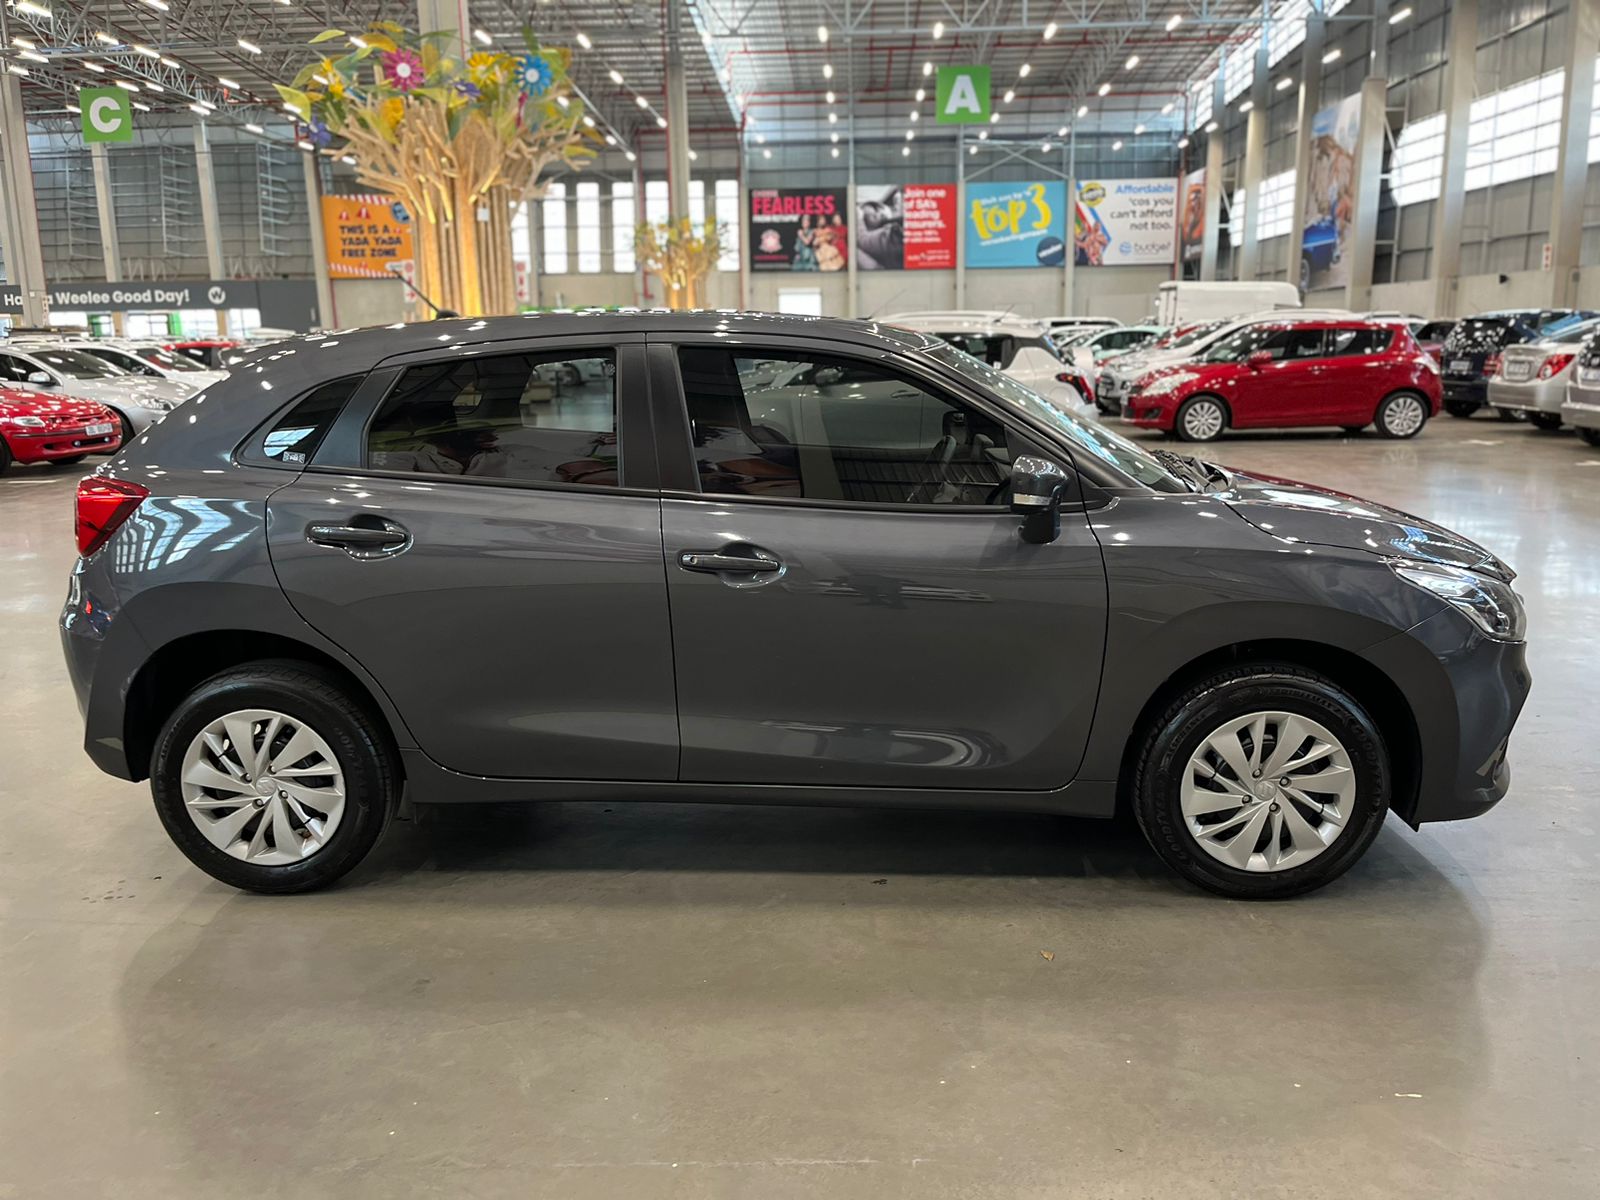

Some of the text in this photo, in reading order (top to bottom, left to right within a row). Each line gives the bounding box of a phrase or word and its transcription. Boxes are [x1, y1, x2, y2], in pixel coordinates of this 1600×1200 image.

[944, 75, 981, 114] A
[89, 97, 122, 133] C
[903, 188, 947, 199] Join one
[1116, 184, 1175, 194] Affordable
[752, 195, 836, 216] FEARLESS
[1129, 198, 1175, 207] 'cos you
[970, 183, 1052, 239] top 3
[1110, 208, 1174, 219] can't afford
[339, 224, 390, 234] THIS IS A
[1129, 221, 1172, 230] not too.
[341, 237, 402, 246] YADA YADA
[342, 248, 397, 257] FREE ZONE
[55, 291, 110, 305] Weelee
[112, 289, 152, 303] Good
[154, 288, 190, 306] Day!
